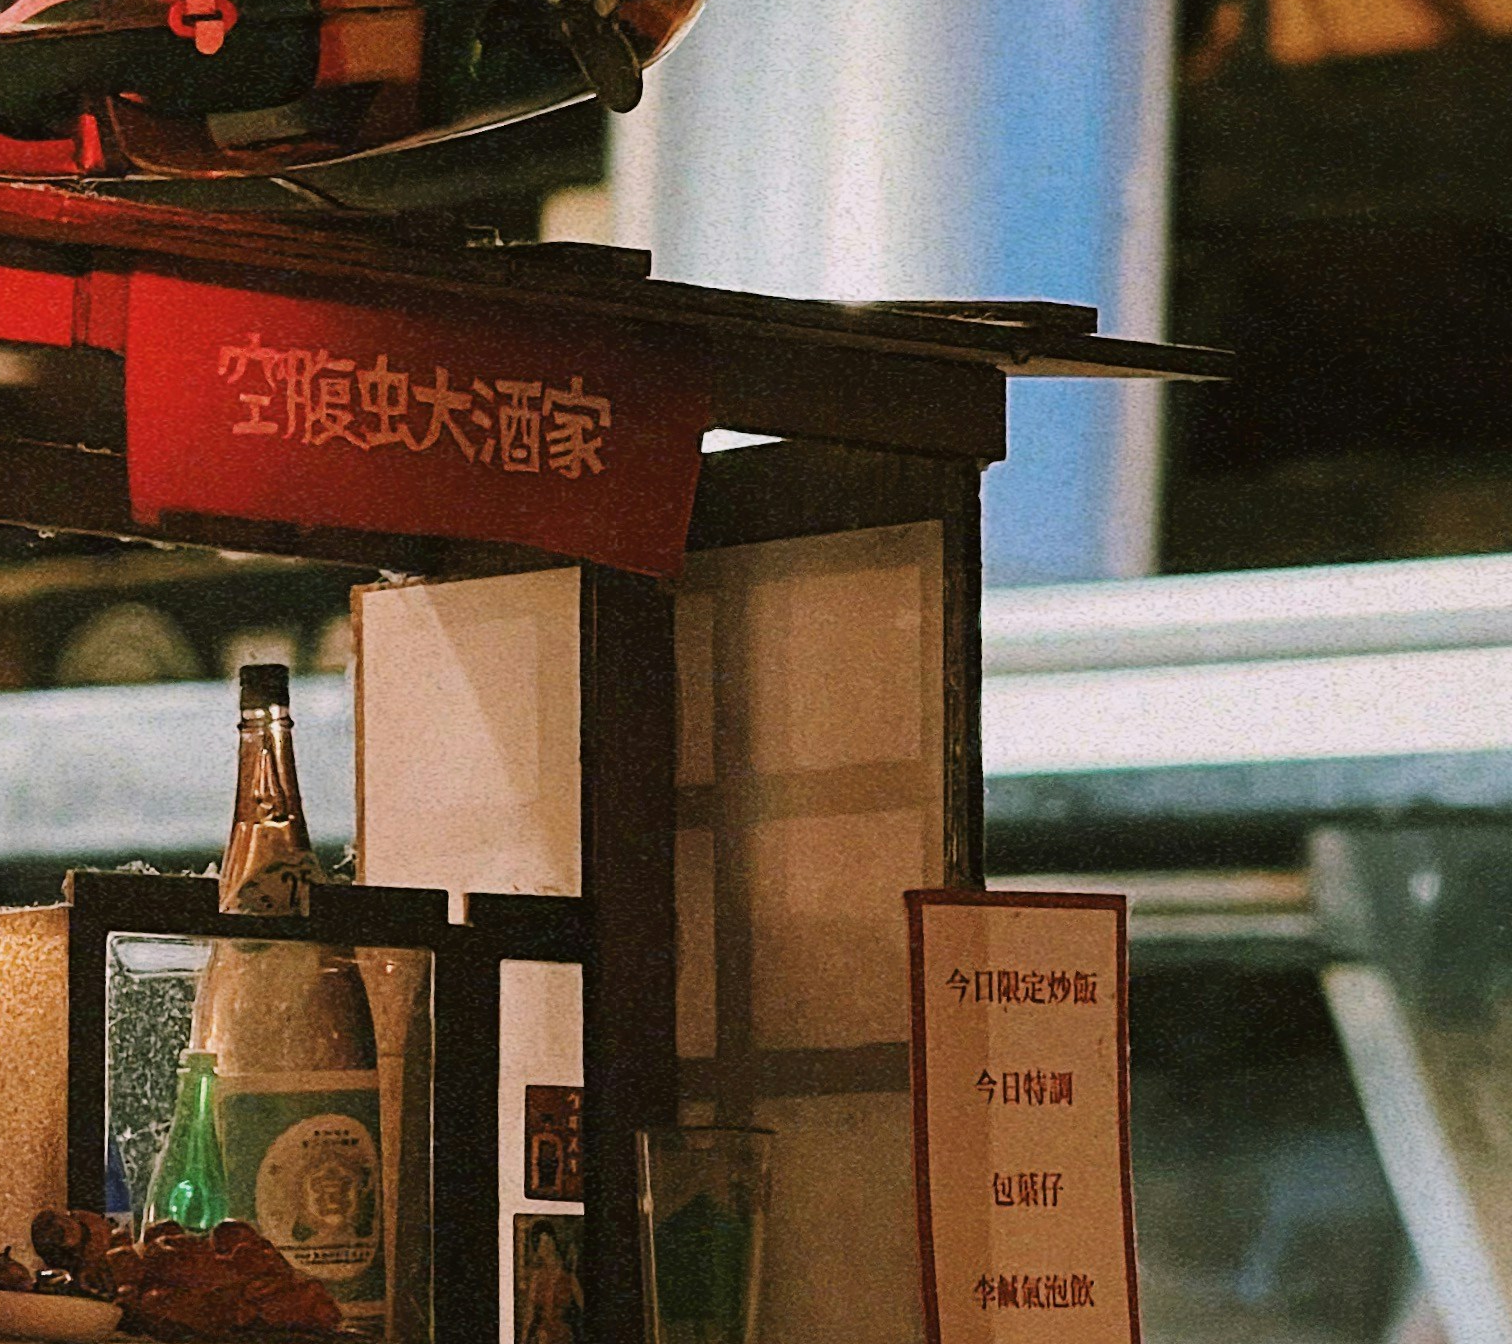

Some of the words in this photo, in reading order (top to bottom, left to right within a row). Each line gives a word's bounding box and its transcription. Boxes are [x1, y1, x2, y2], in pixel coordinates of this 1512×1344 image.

[217, 331, 612, 480] 空腹虫大酒家
[945, 967, 1098, 1005] 今日限定炒飯
[974, 1067, 1074, 1106] 今日特調
